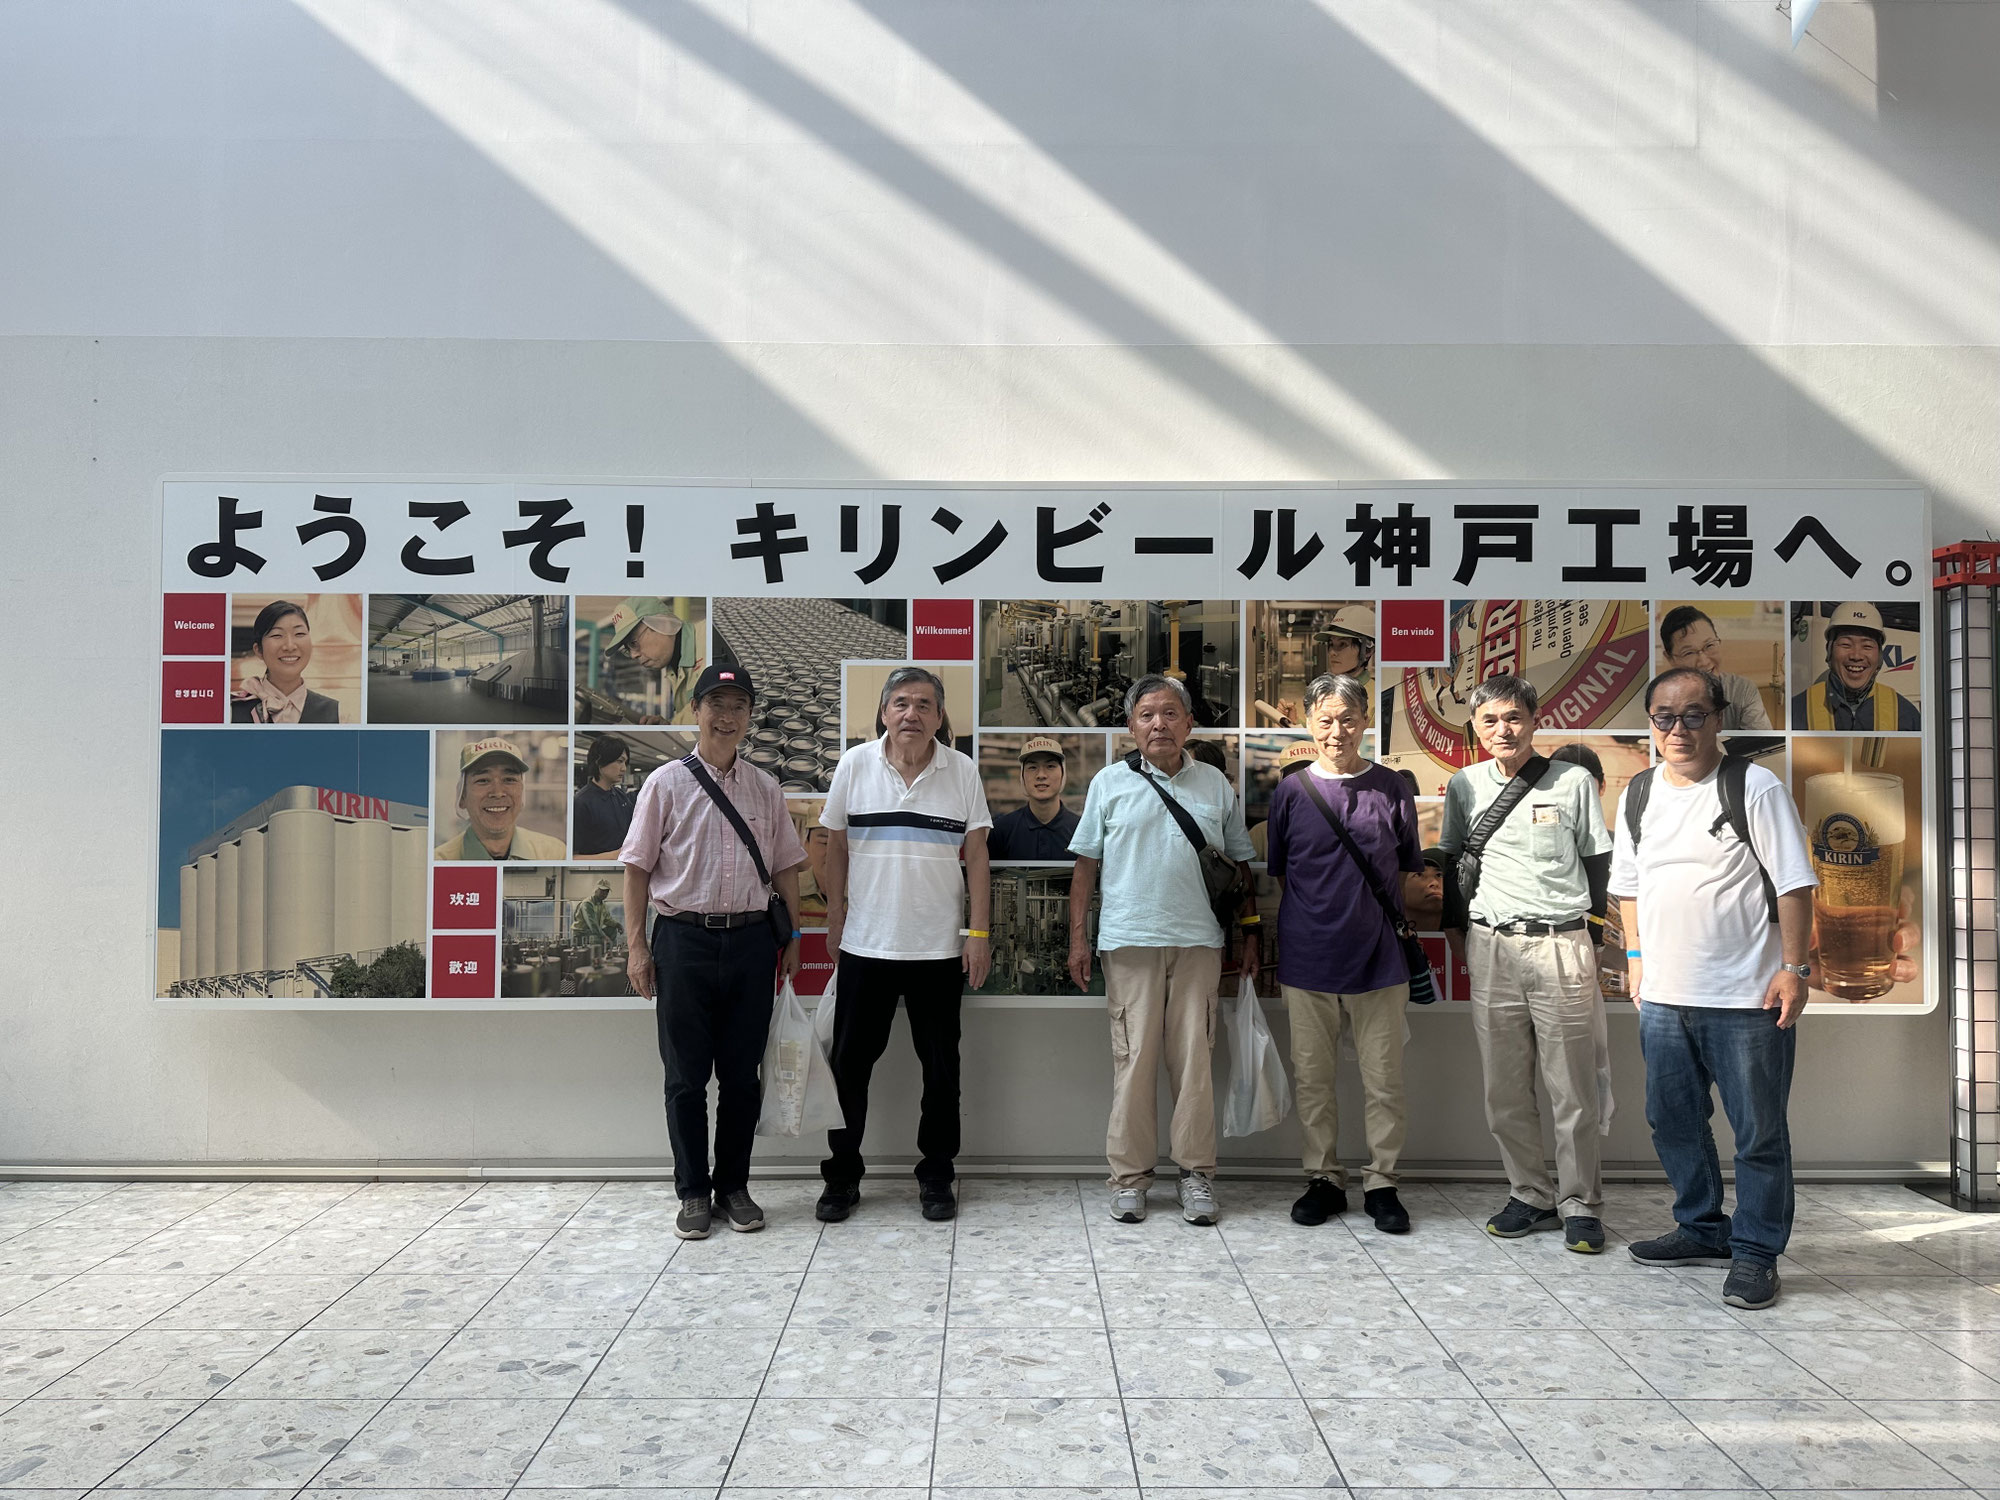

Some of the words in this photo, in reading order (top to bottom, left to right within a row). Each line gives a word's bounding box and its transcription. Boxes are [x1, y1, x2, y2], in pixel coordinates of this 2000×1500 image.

[186, 494, 646, 584] ようこそ！
[730, 501, 1914, 589] キリンビール神戸工場へ。
[1563, 610, 1574, 626] up
[1579, 604, 1588, 627] see
[174, 620, 215, 630] Welcome
[914, 625, 971, 635] Willkommen!
[1392, 627, 1408, 636] Ben
[1411, 627, 1434, 636] vindo
[1482, 600, 1517, 681] GER
[1532, 628, 1543, 651] The
[1547, 641, 1556, 649] a
[1560, 627, 1574, 659] Open
[1882, 644, 1917, 668] KL
[1540, 649, 1637, 730] RIGINAL
[474, 741, 513, 752] KIRIN
[1027, 740, 1053, 750] KIRIN
[1425, 726, 1454, 756] KIRIN
[1289, 747, 1319, 757] KIRIN
[317, 786, 390, 822] KIRIN
[1824, 851, 1863, 864] KIRIN
[449, 892, 480, 906] 欢迎
[448, 960, 478, 975] 歡迎
[800, 962, 834, 970] ommen
